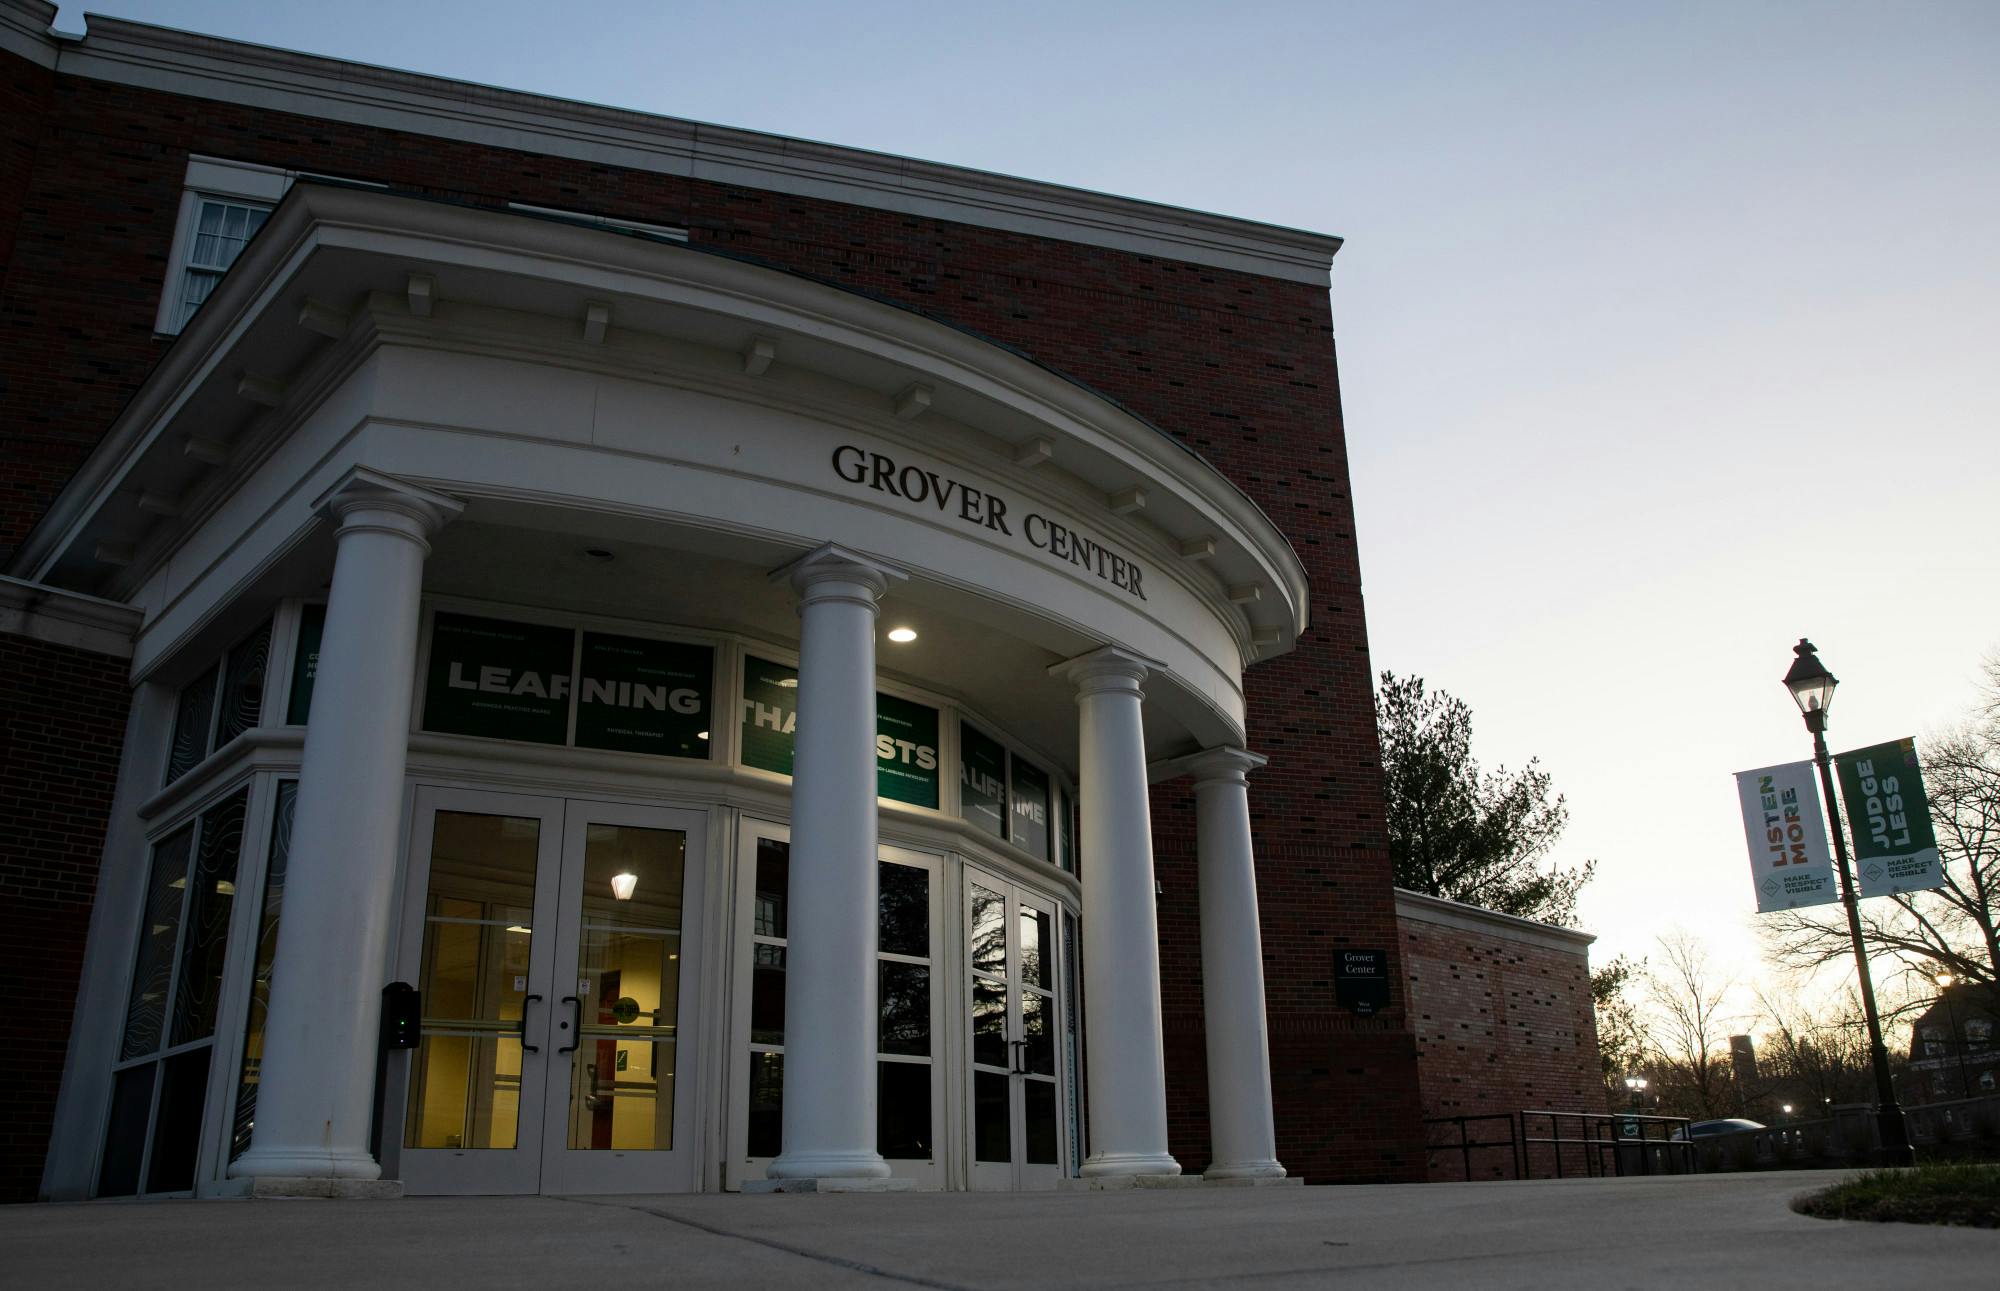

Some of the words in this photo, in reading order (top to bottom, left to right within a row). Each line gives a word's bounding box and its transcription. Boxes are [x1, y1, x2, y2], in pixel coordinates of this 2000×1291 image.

[832, 445, 1013, 536] GROVER
[1023, 513, 1148, 601] CENTER
[448, 660, 701, 715] LEARNING
[742, 699, 797, 734] THA
[877, 733, 937, 771] STS
[1856, 759, 1890, 849] JUDGE
[1882, 775, 1911, 846] LESS
[1758, 775, 1788, 867] LISTEN
[1781, 787, 1808, 865] MORE
[1888, 857, 1915, 867] MAKE
[1888, 860, 1933, 873] RESPECT
[1783, 873, 1811, 883] MAKE
[1889, 867, 1928, 879] VISIBLE
[1784, 877, 1829, 889] RESPECT
[1785, 884, 1823, 895] VISIBLE
[1344, 952, 1375, 962] Grover
[1345, 964, 1376, 974] Center
